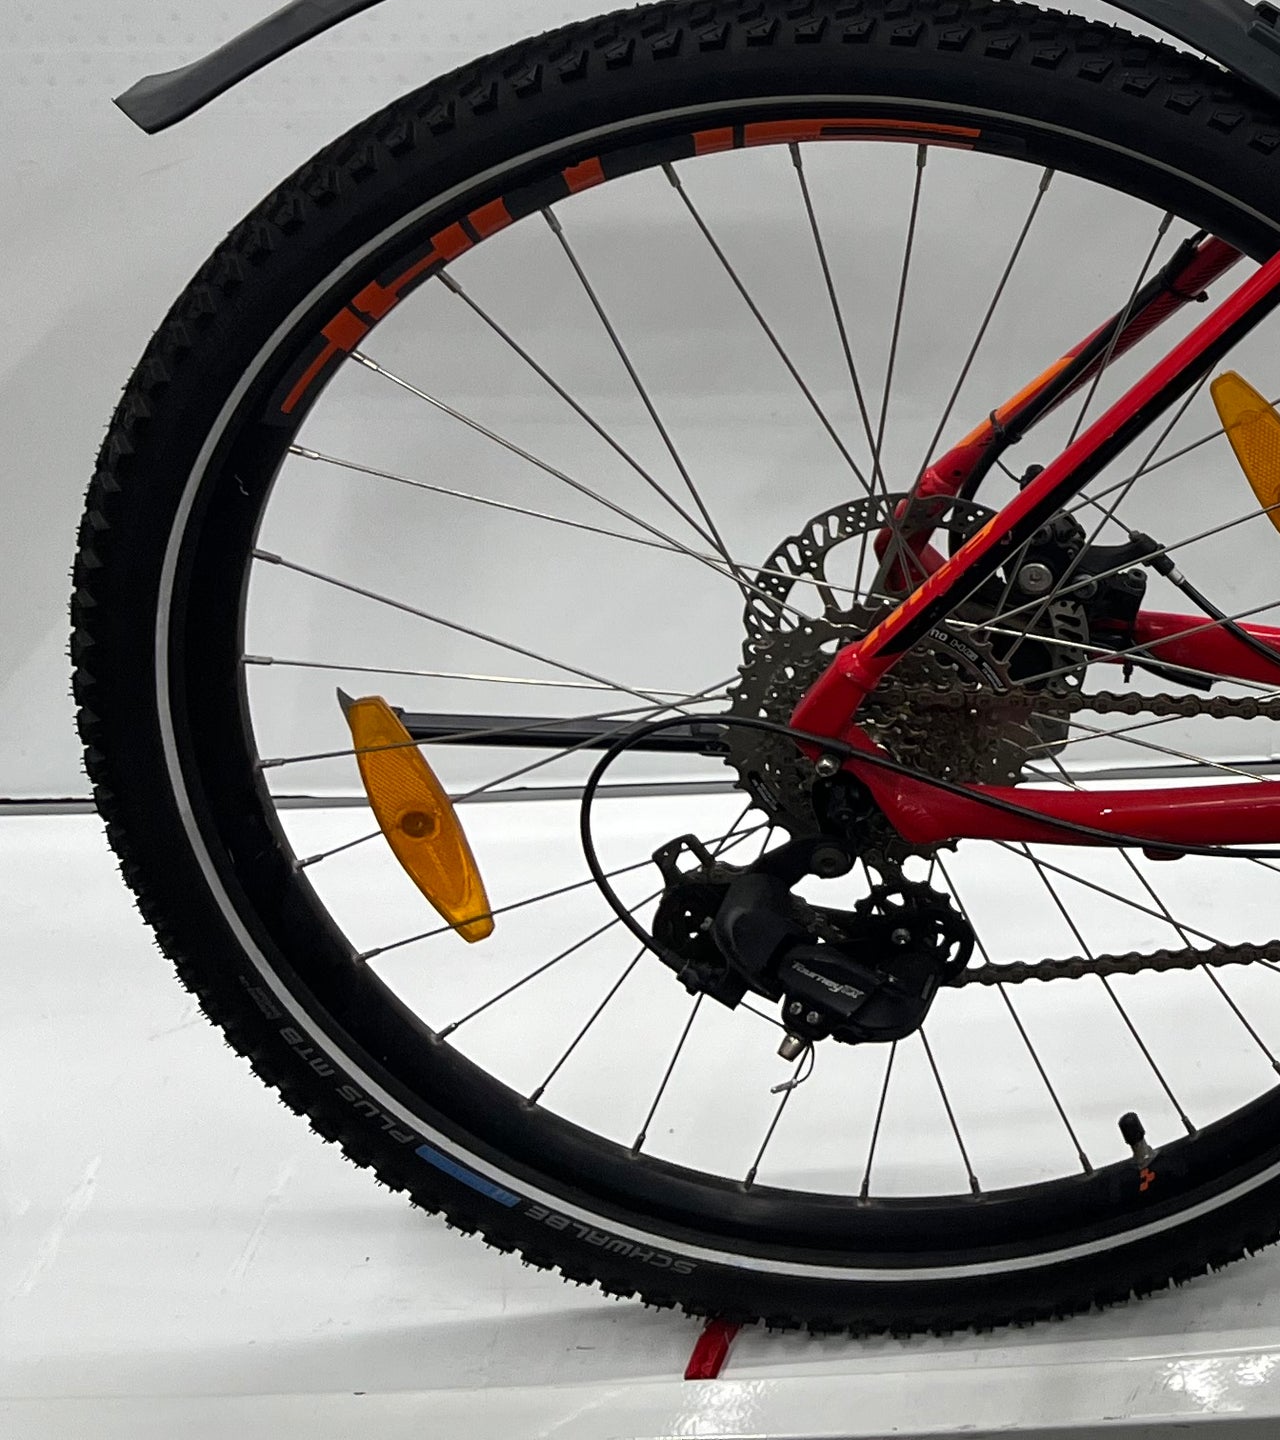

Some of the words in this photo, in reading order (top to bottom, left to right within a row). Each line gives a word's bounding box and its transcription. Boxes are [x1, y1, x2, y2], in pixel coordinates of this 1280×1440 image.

[279, 1026, 336, 1077] MTB
[335, 1084, 415, 1144] PLUS
[523, 1205, 698, 1275] SCHWALBE
